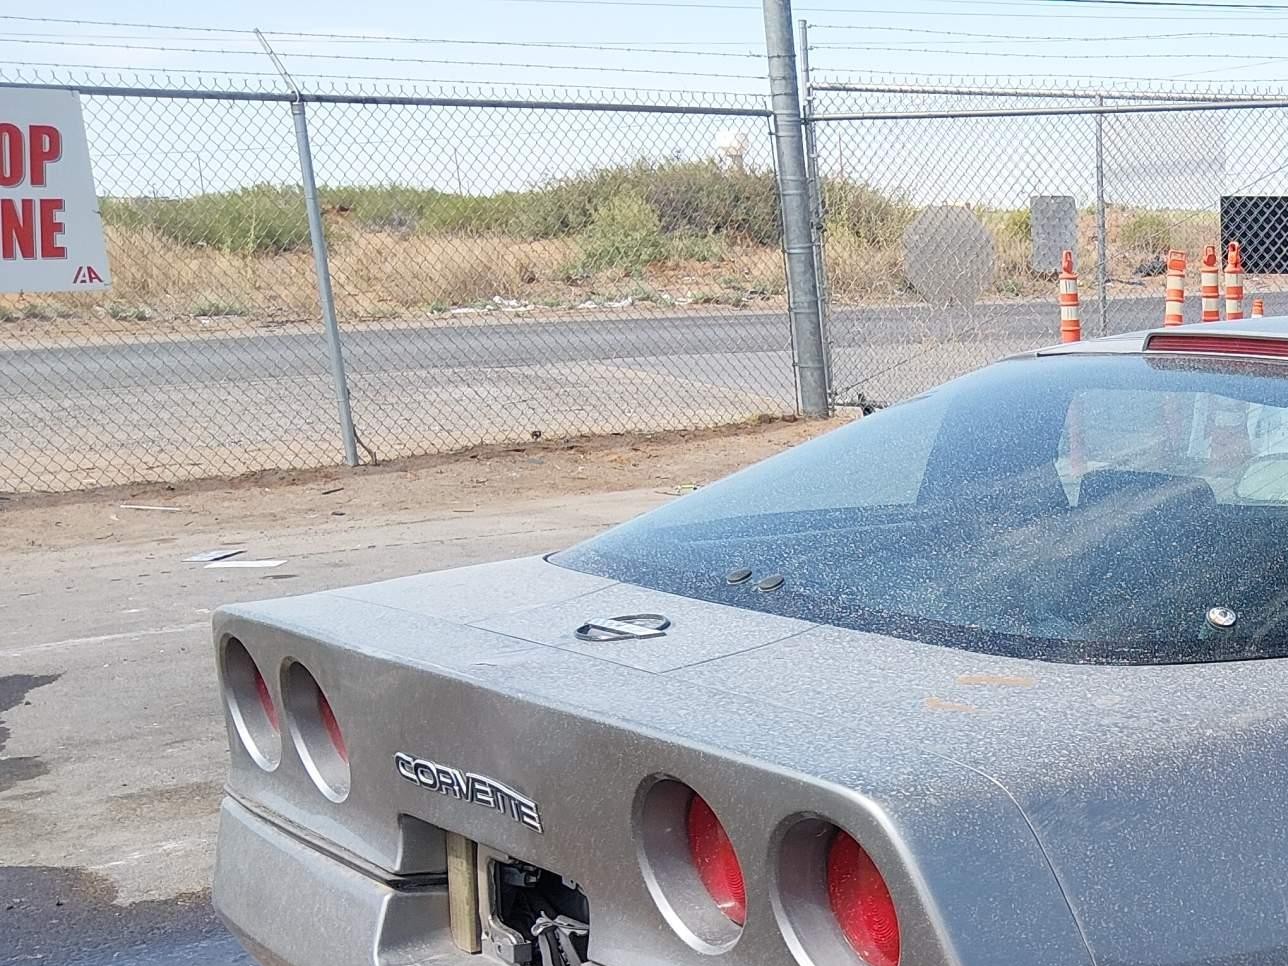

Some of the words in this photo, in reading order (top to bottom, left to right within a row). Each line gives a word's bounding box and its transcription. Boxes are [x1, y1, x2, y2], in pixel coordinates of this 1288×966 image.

[0, 122, 62, 188] OP
[0, 198, 67, 261] NE
[394, 751, 545, 834] CORVETTE
